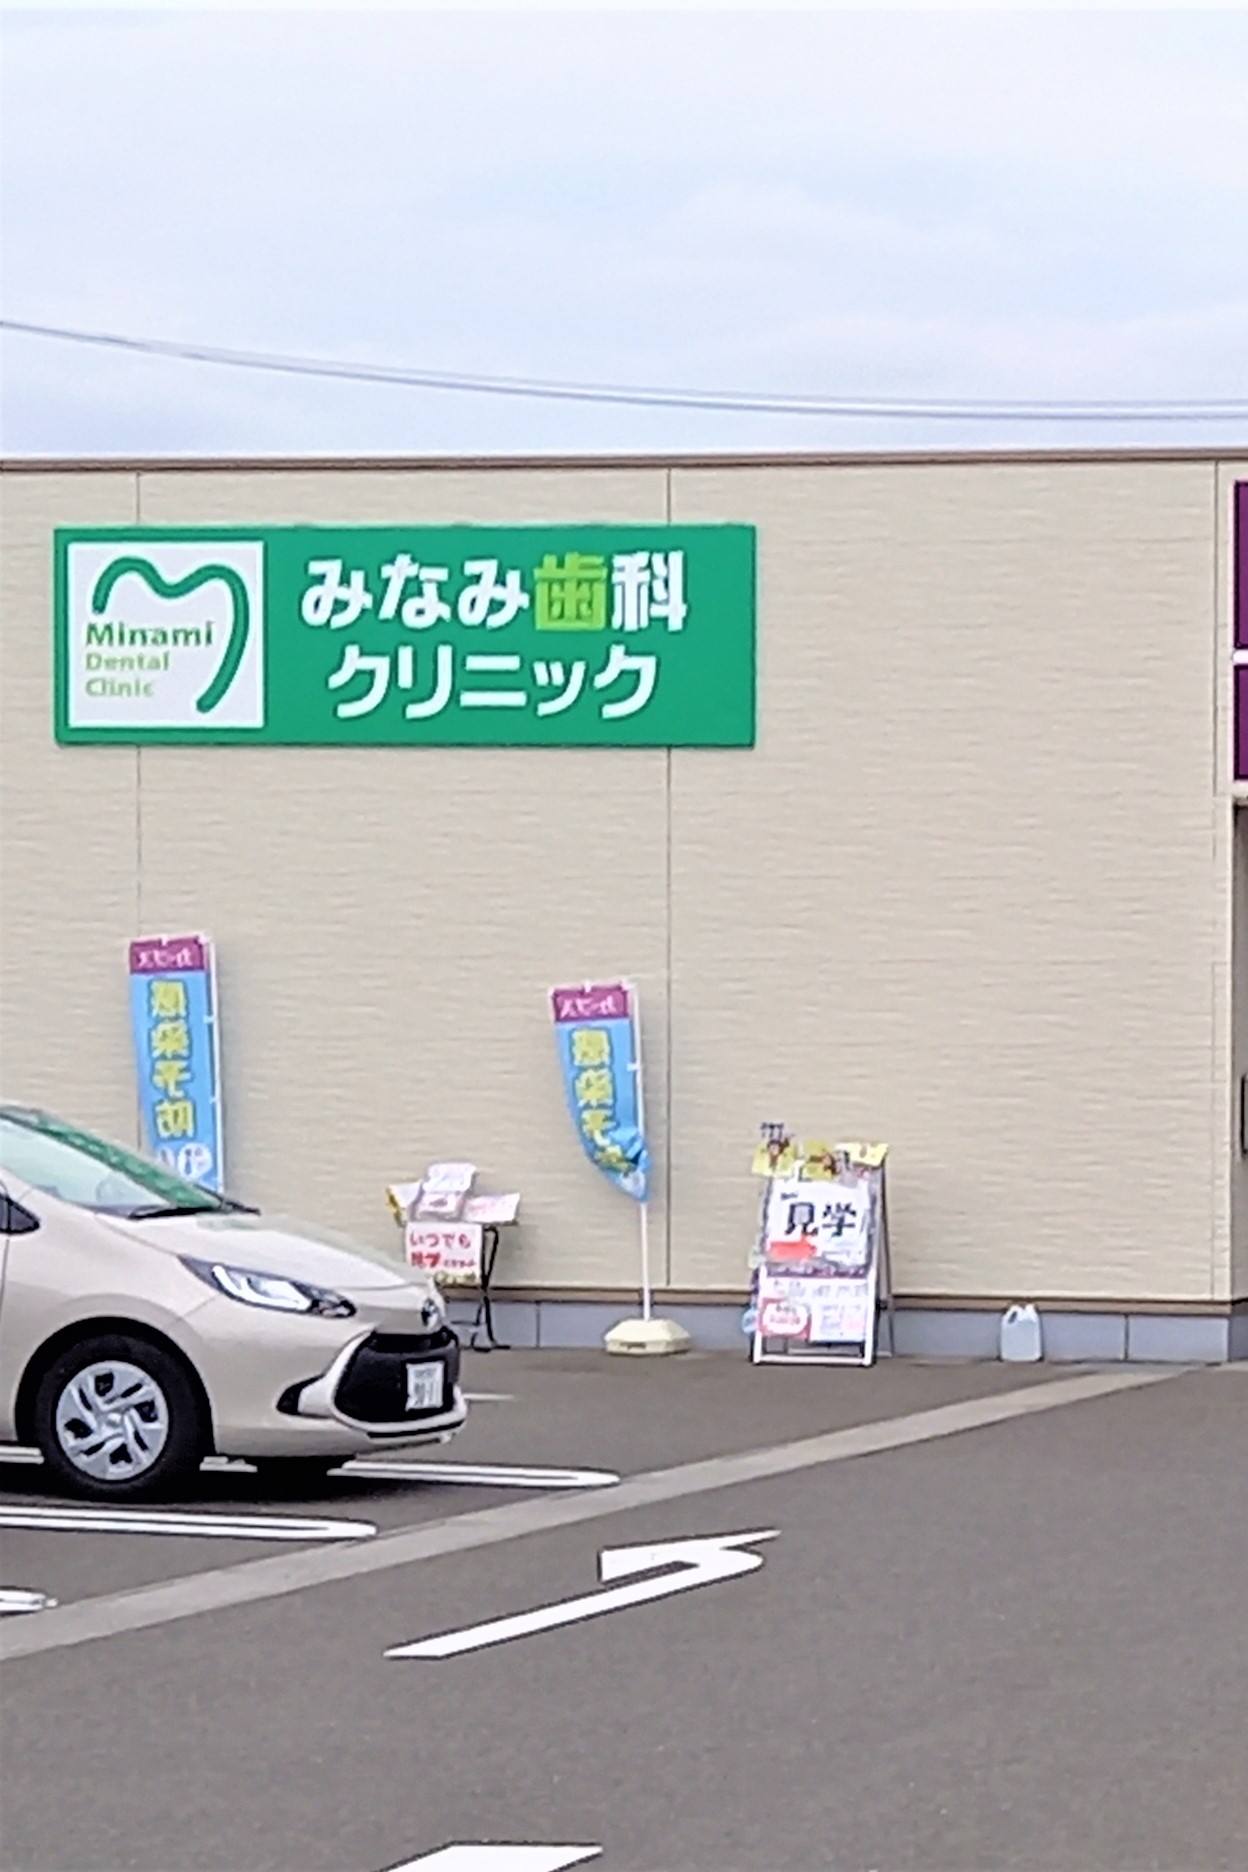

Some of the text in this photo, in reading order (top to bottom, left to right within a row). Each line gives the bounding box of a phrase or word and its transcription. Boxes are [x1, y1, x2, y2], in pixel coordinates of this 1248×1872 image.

[301, 550, 688, 633] みなみ歯科
[86, 620, 215, 647] Minami
[85, 650, 170, 671] Dental
[85, 677, 154, 697] Clinic
[328, 644, 660, 719] クリニック
[785, 1202, 857, 1237] 見学
